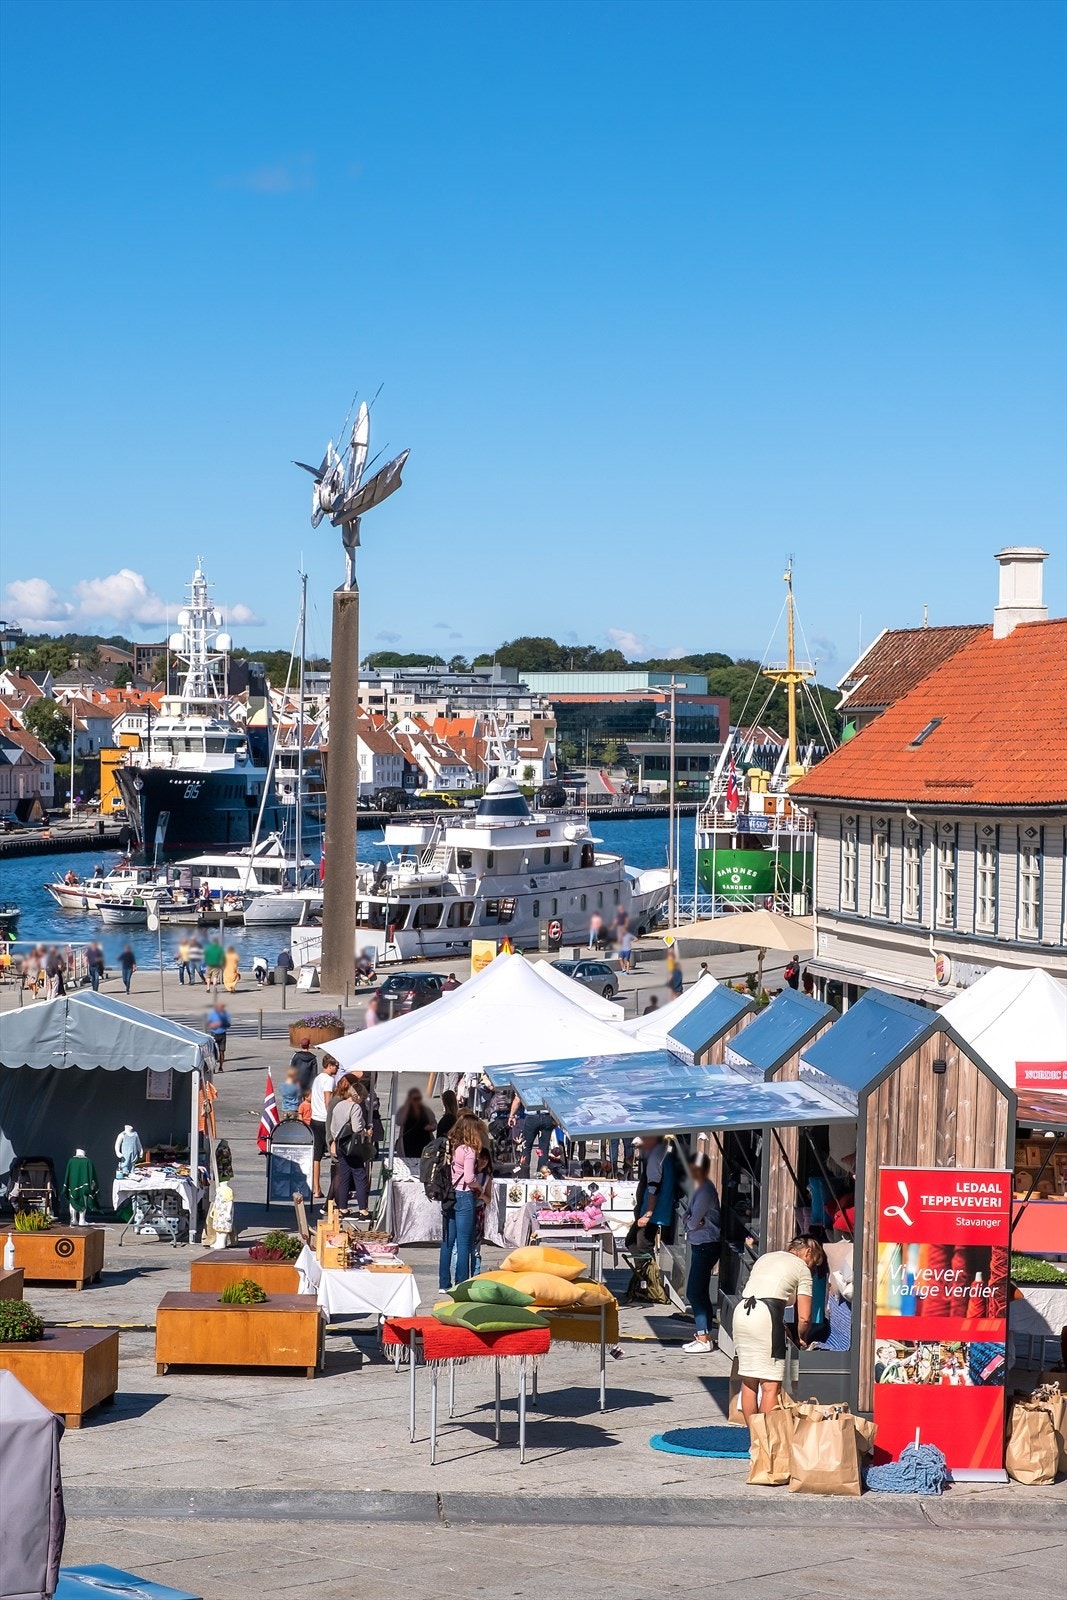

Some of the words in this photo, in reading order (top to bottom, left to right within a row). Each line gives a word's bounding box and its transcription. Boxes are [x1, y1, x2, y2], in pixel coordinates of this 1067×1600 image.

[717, 867, 758, 878] SANDNES
[1025, 1071, 1061, 1079] NORDIC
[956, 1183, 1002, 1193] LEDAAL
[920, 1196, 1002, 1207] TEPPEVEVERI
[956, 1217, 1001, 1228] Stavanger
[890, 1263, 907, 1281] Vi
[912, 1268, 963, 1282] vever
[892, 1283, 939, 1299] varige
[944, 1283, 999, 1298] verdier
